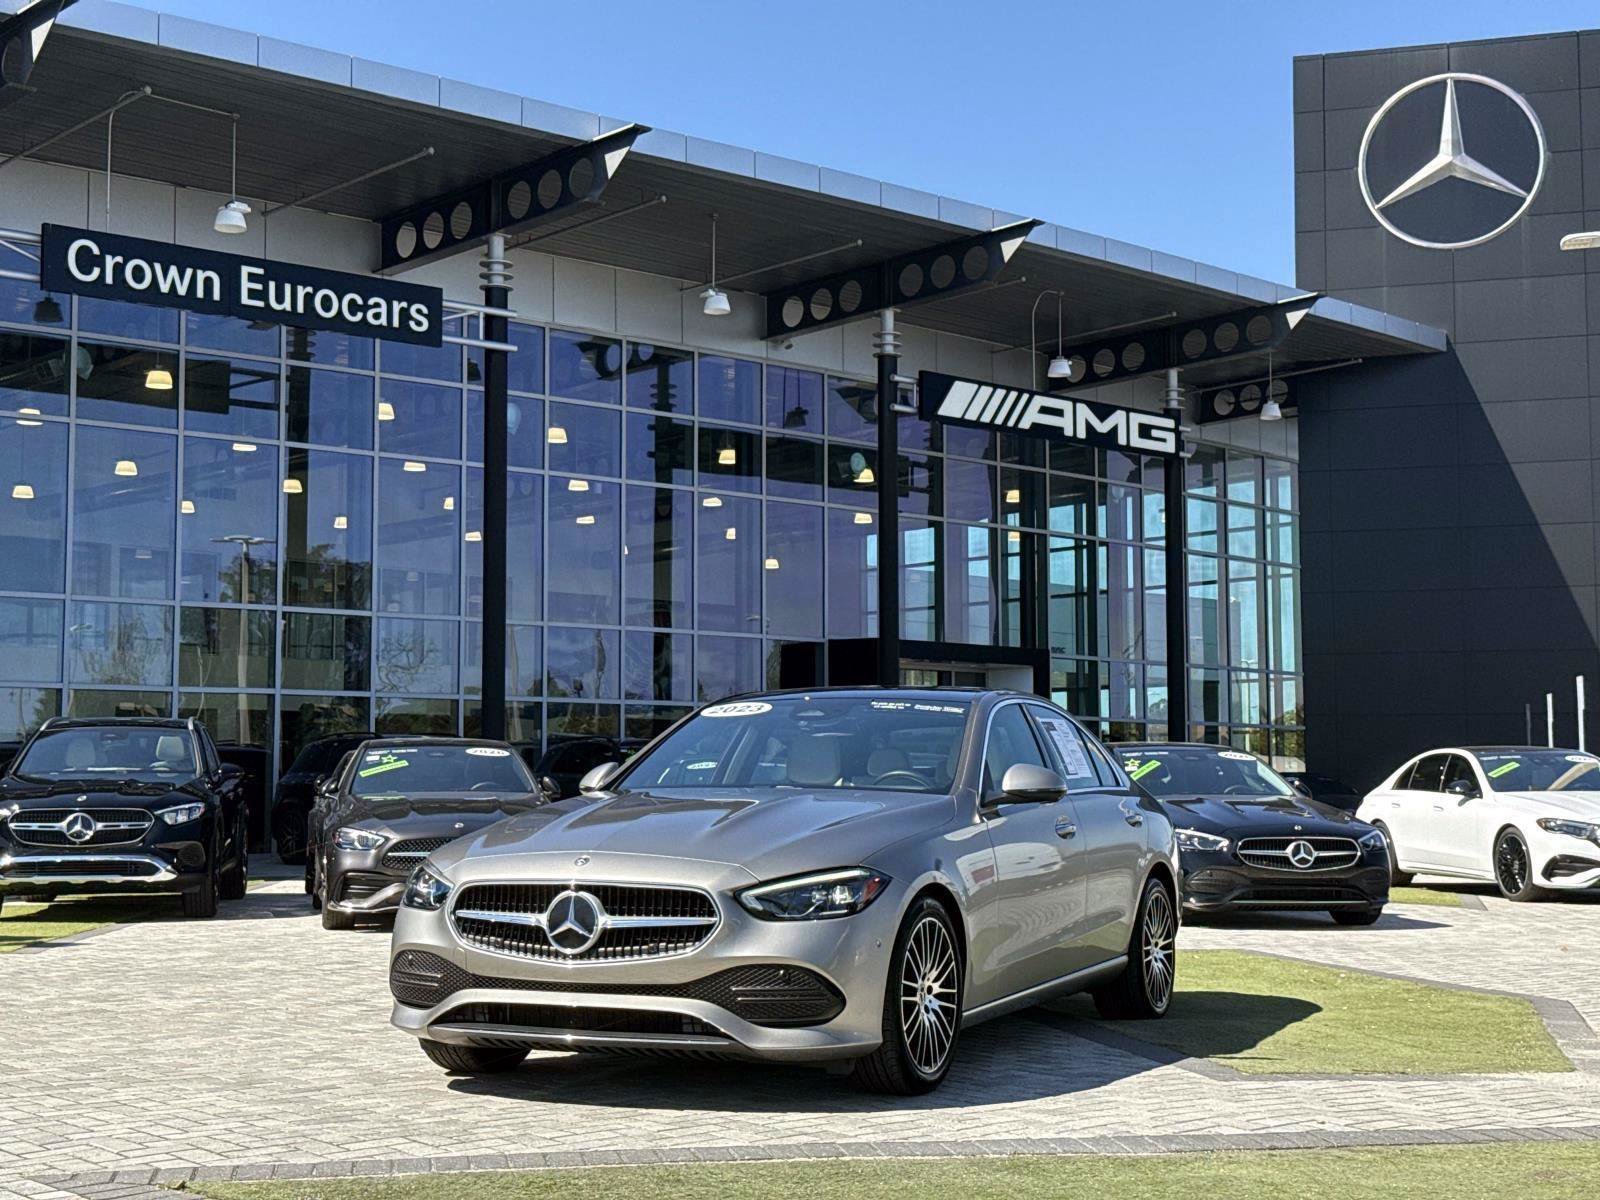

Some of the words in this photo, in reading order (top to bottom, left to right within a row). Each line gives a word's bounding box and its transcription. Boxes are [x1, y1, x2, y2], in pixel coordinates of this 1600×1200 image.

[66, 238, 221, 302] Crown
[240, 265, 430, 333] Eurocars
[1018, 394, 1177, 454] AMG
[708, 704, 765, 714] 2023
